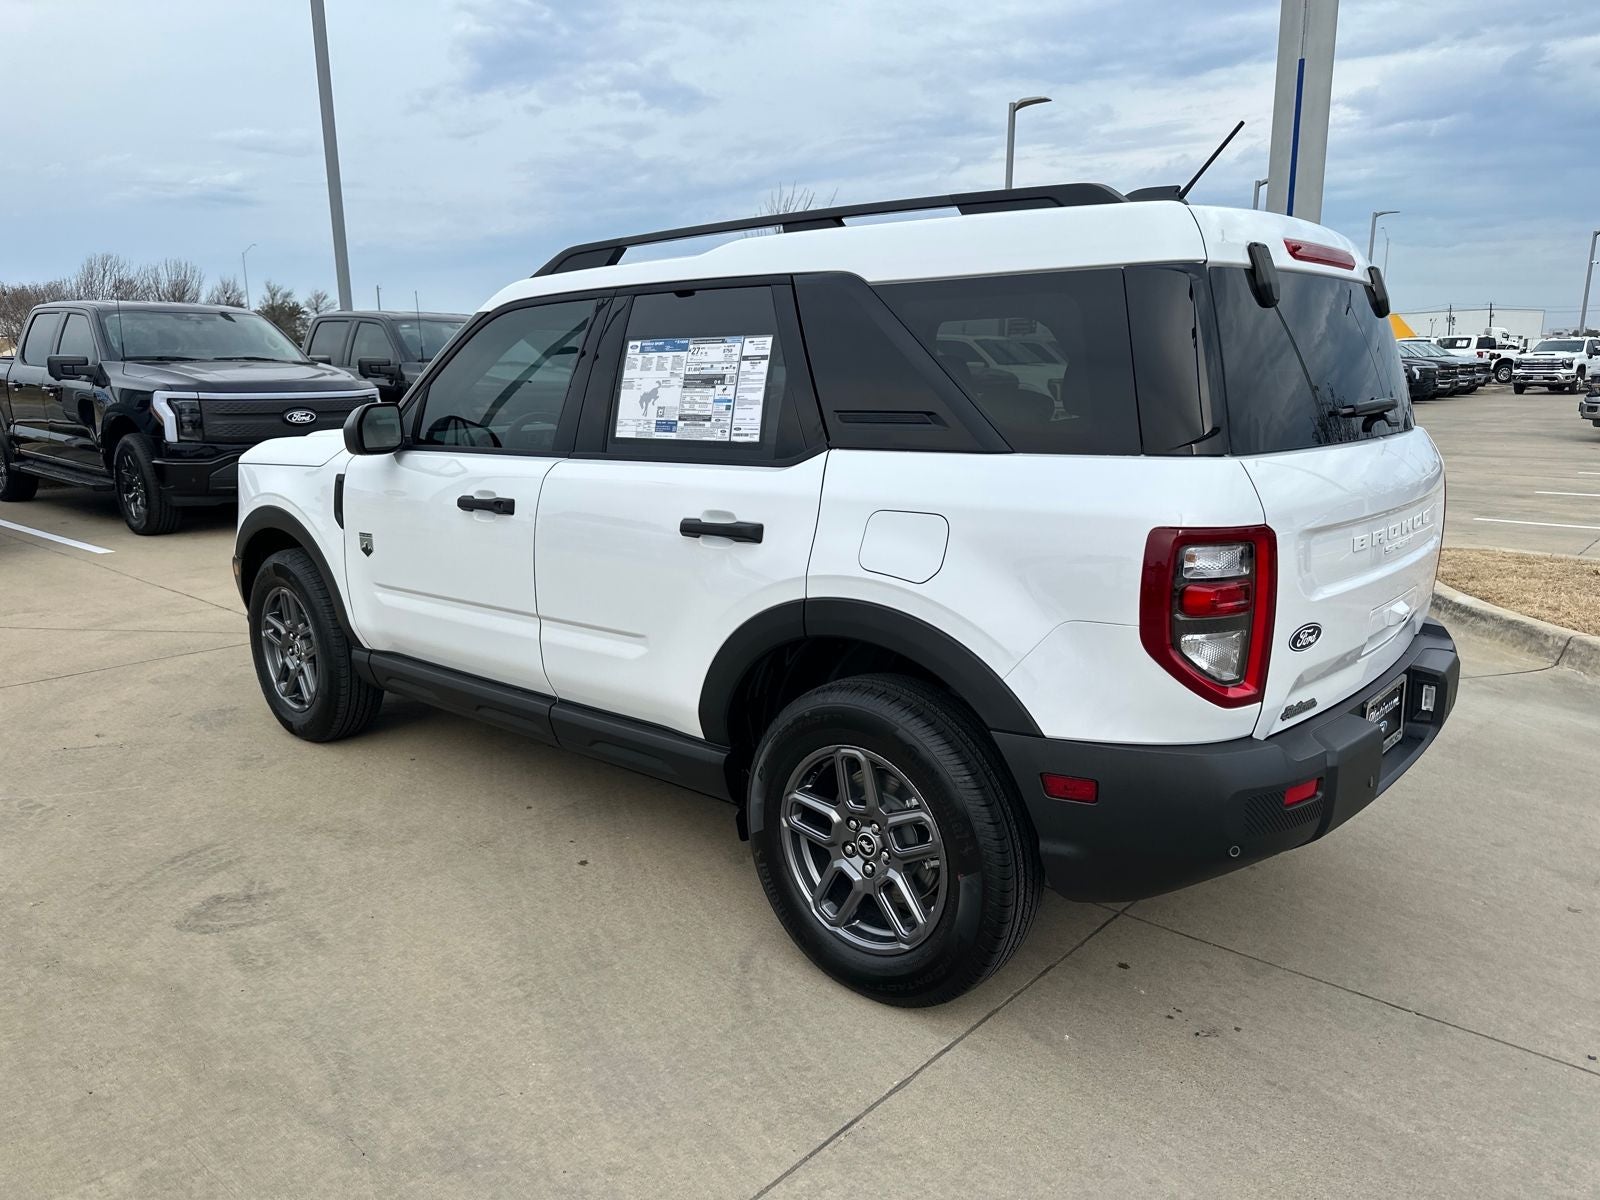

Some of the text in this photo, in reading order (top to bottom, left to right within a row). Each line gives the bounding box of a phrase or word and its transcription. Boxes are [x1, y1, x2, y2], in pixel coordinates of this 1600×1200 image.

[290, 411, 312, 423] Ford
[1352, 508, 1431, 553] BRONCO
[1294, 627, 1319, 648] Ford
